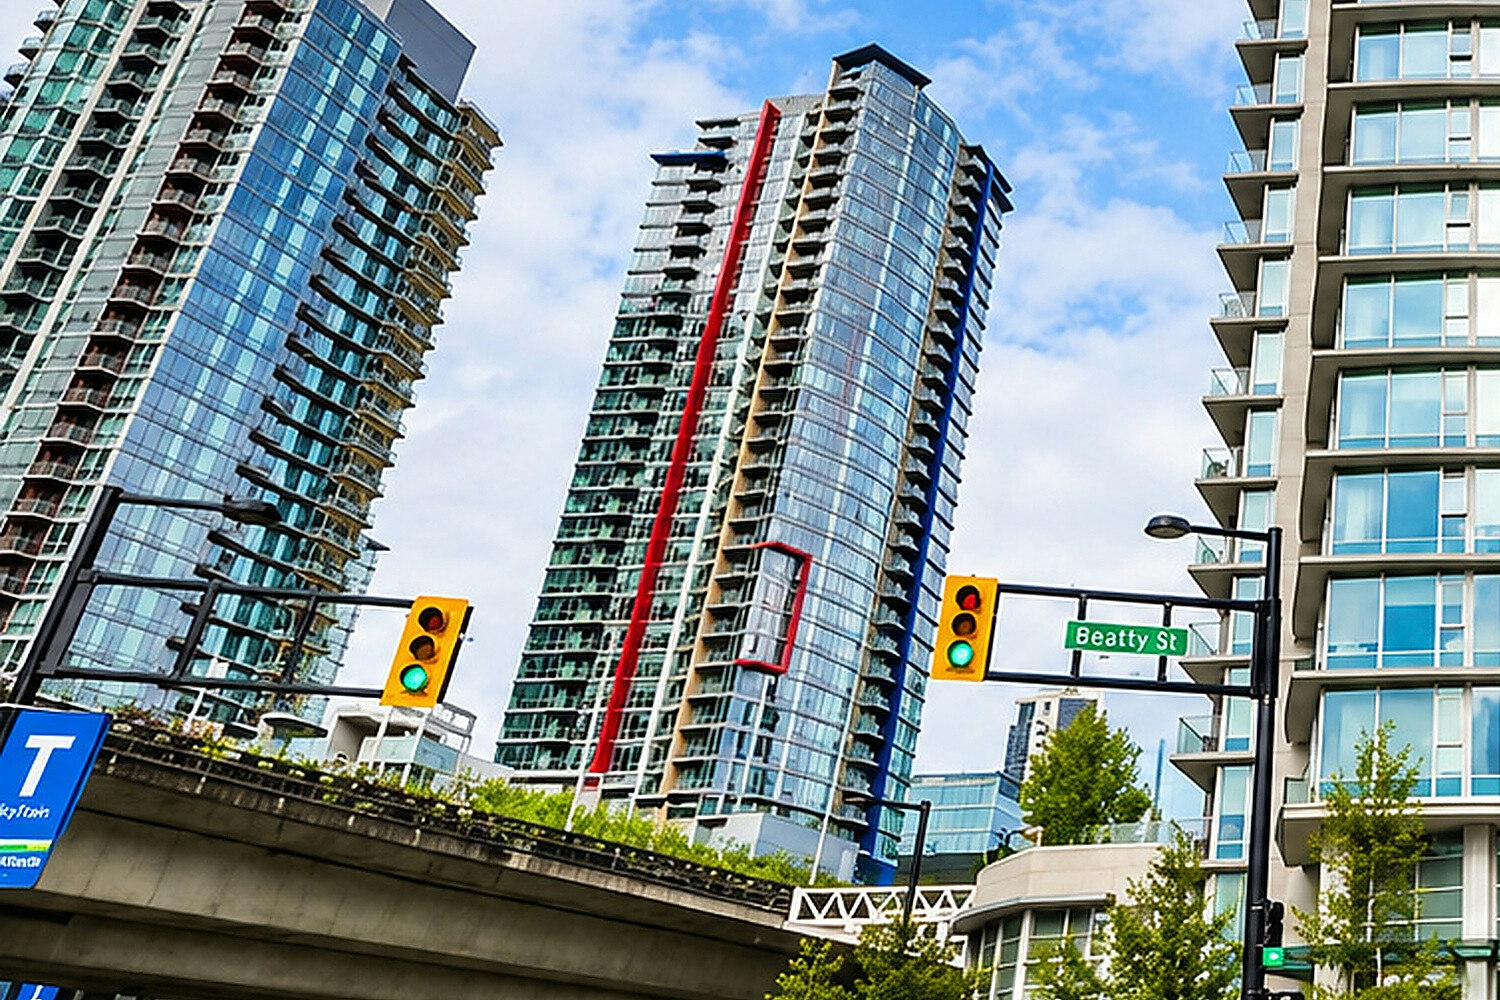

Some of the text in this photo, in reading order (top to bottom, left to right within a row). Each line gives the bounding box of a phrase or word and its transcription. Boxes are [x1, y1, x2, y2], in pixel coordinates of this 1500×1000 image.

[1075, 626, 1177, 652] Beatty St
[19, 734, 77, 797] T
